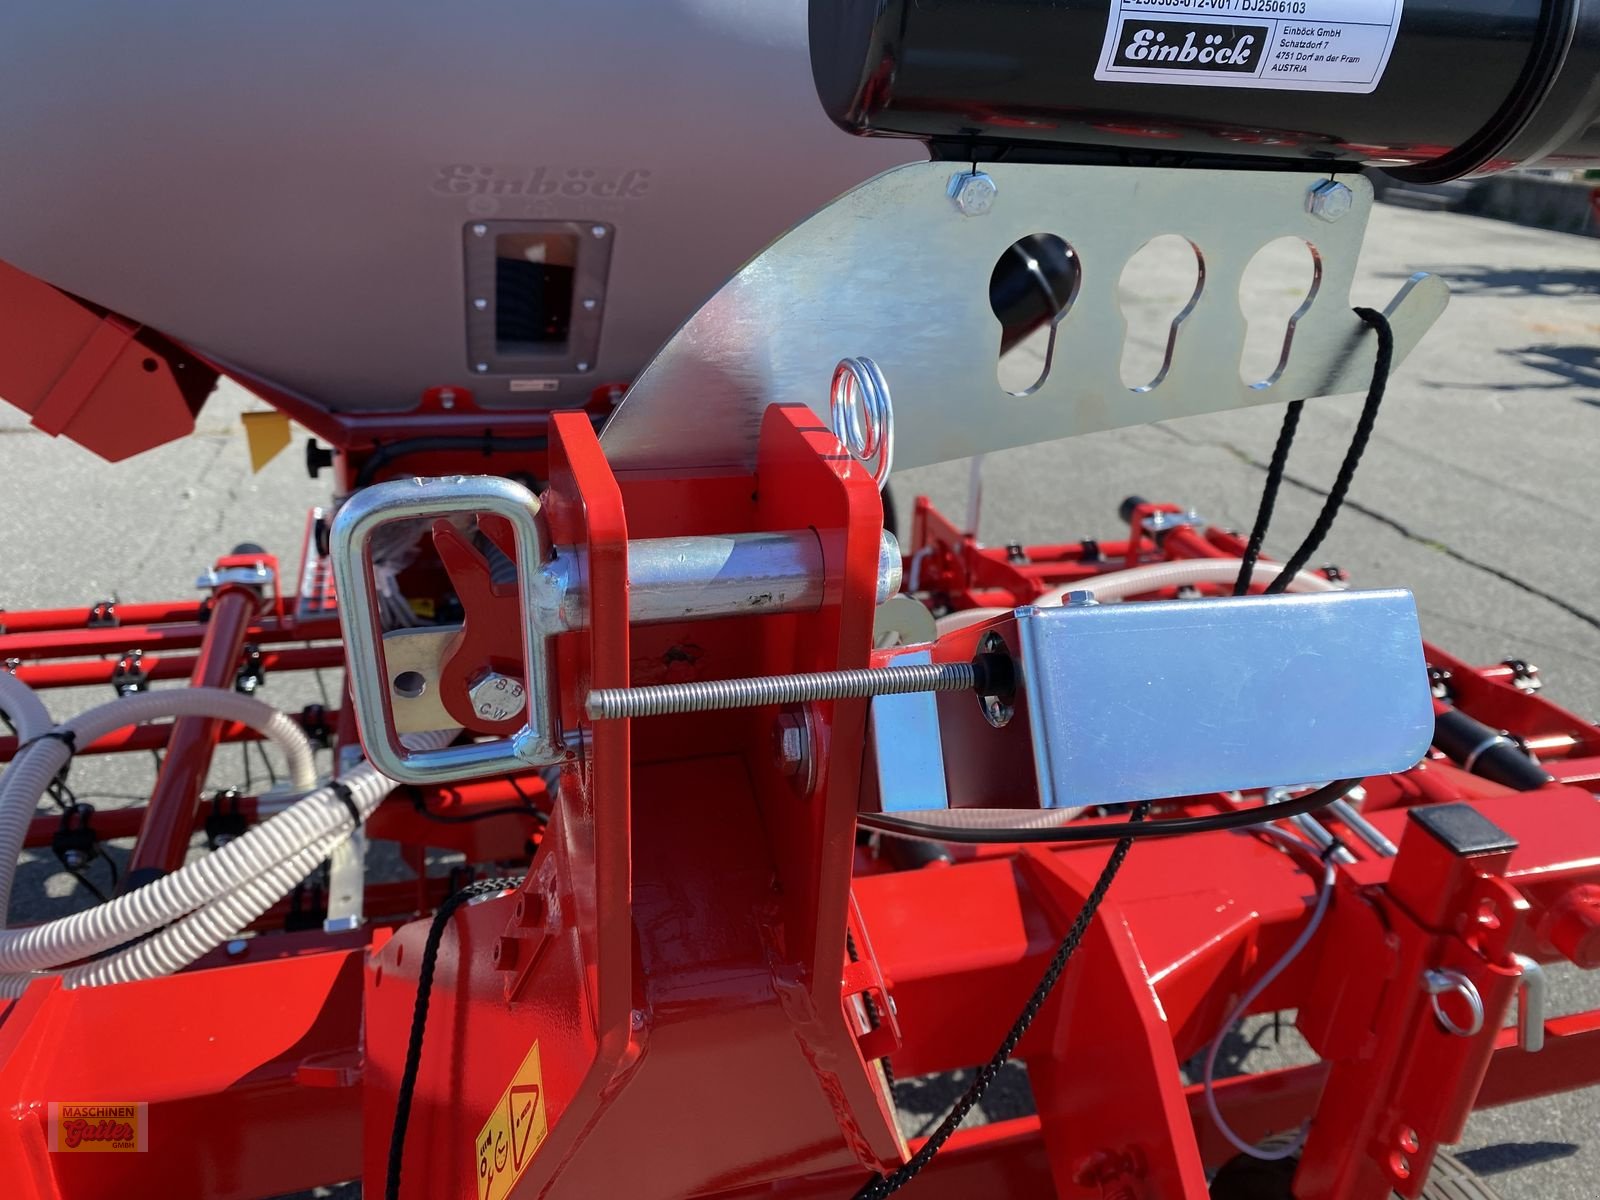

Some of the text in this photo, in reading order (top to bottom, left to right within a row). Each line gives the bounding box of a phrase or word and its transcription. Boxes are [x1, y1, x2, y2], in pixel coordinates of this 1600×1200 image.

[1123, 0, 1305, 14] -3-012-V01 / DJ2506103
[1283, 26, 1342, 38] Einböck GmbH
[1125, 29, 1255, 65] Einböck
[1280, 39, 1330, 49] Schatzdorf 7
[1276, 51, 1294, 60] 4751
[1296, 52, 1315, 61] Dorf
[1326, 54, 1339, 62] der
[1340, 54, 1361, 63] Pram
[1271, 63, 1308, 73] AUSTRIA
[431, 164, 652, 198] Einböck
[495, 678, 523, 697] 8.8
